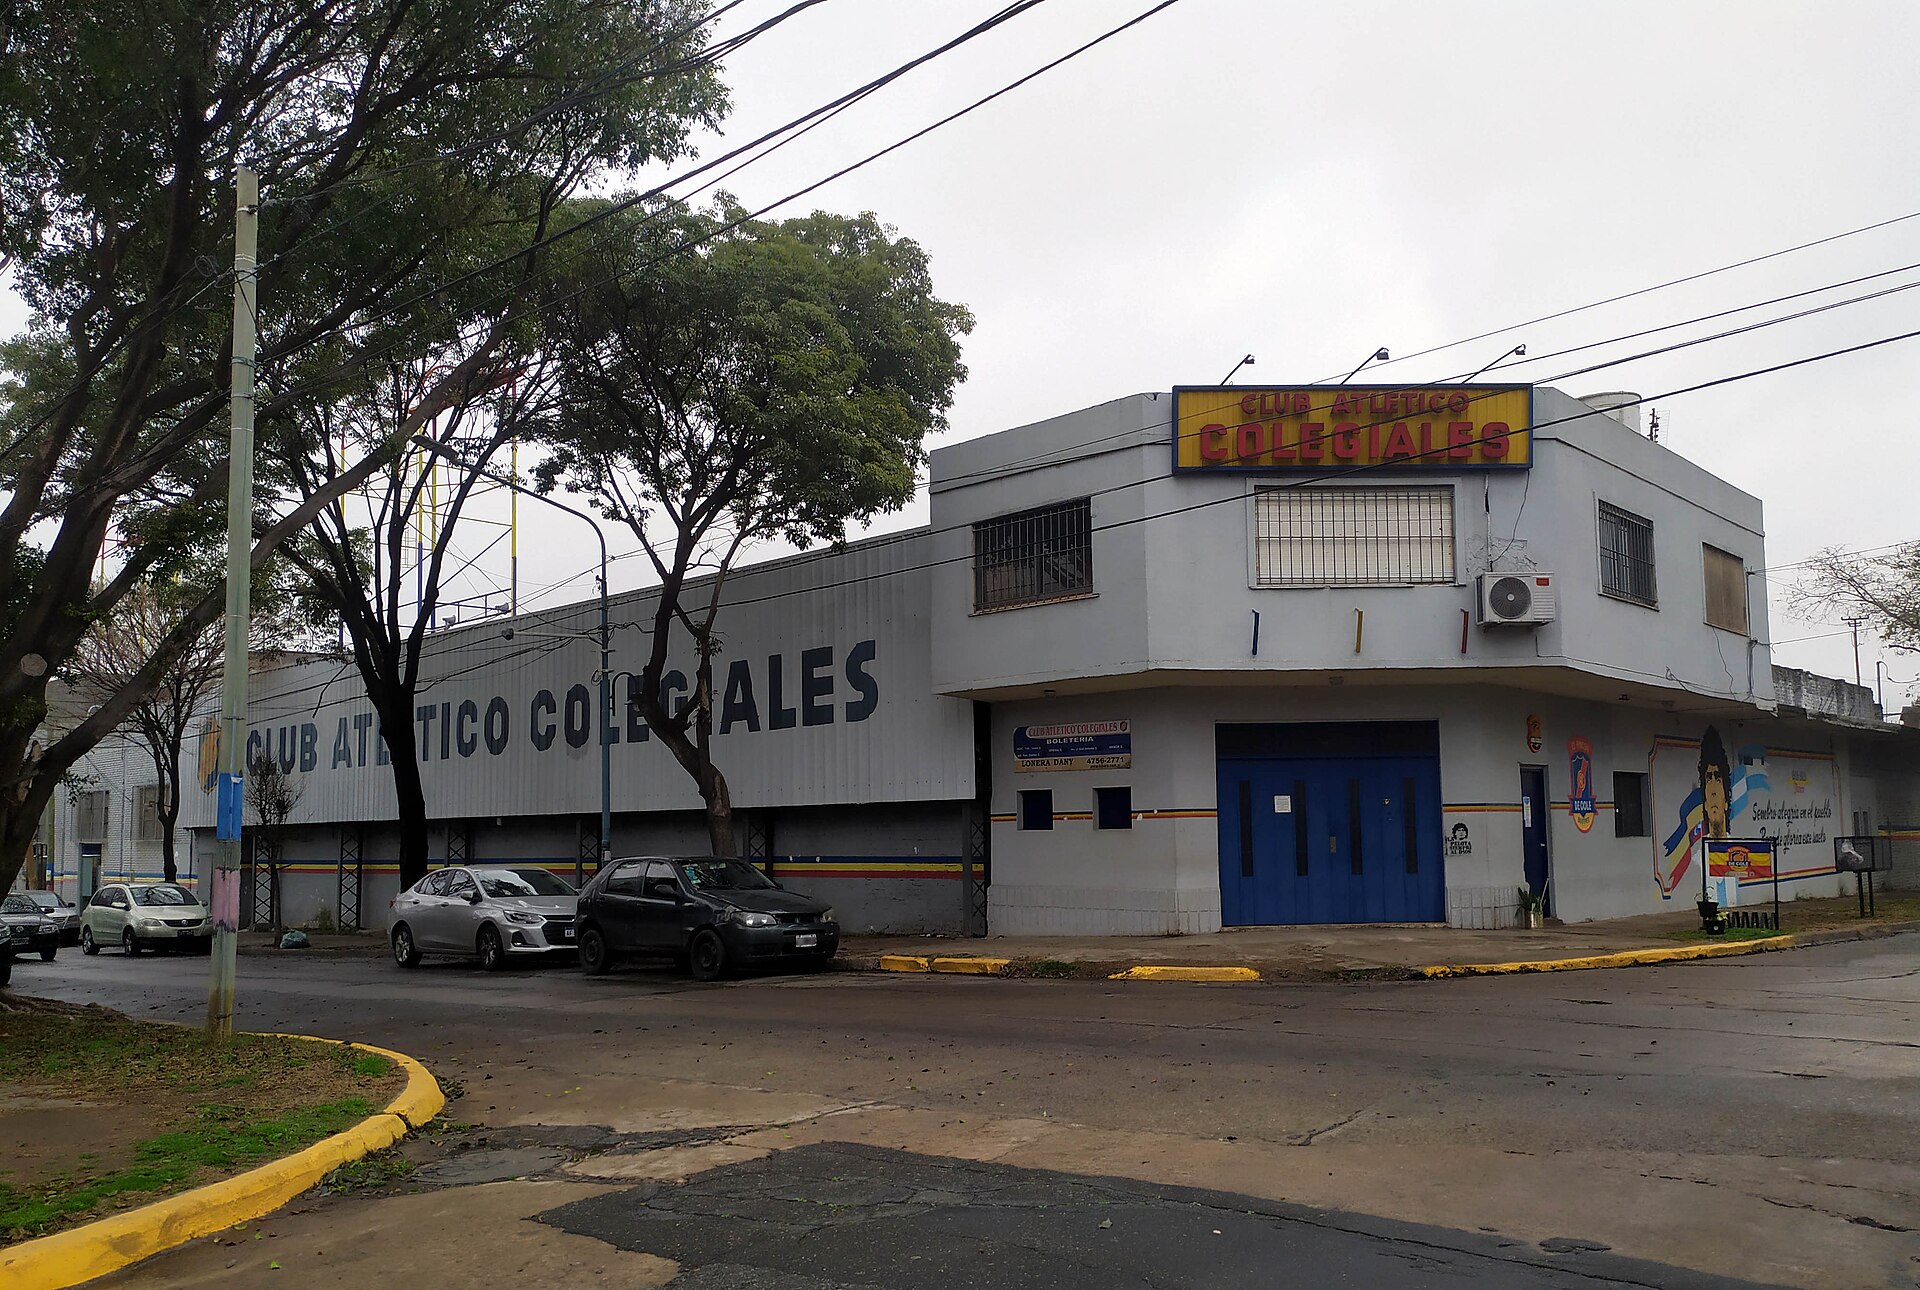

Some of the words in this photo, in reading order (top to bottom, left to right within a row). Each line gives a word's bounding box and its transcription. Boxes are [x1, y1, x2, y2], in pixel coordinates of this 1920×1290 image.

[1241, 393, 1311, 416] CLUB
[1330, 391, 1470, 415] ATLETICO
[1200, 421, 1511, 460] COLEGIALES
[246, 722, 318, 776] CLUB
[331, 696, 509, 770] ATLTICO
[1028, 727, 1045, 737] CLUB
[1046, 736, 1094, 745] BOLETERIA
[1021, 759, 1051, 768] LONERA
[1054, 758, 1074, 766] DANY
[1574, 800, 1580, 811] DE
